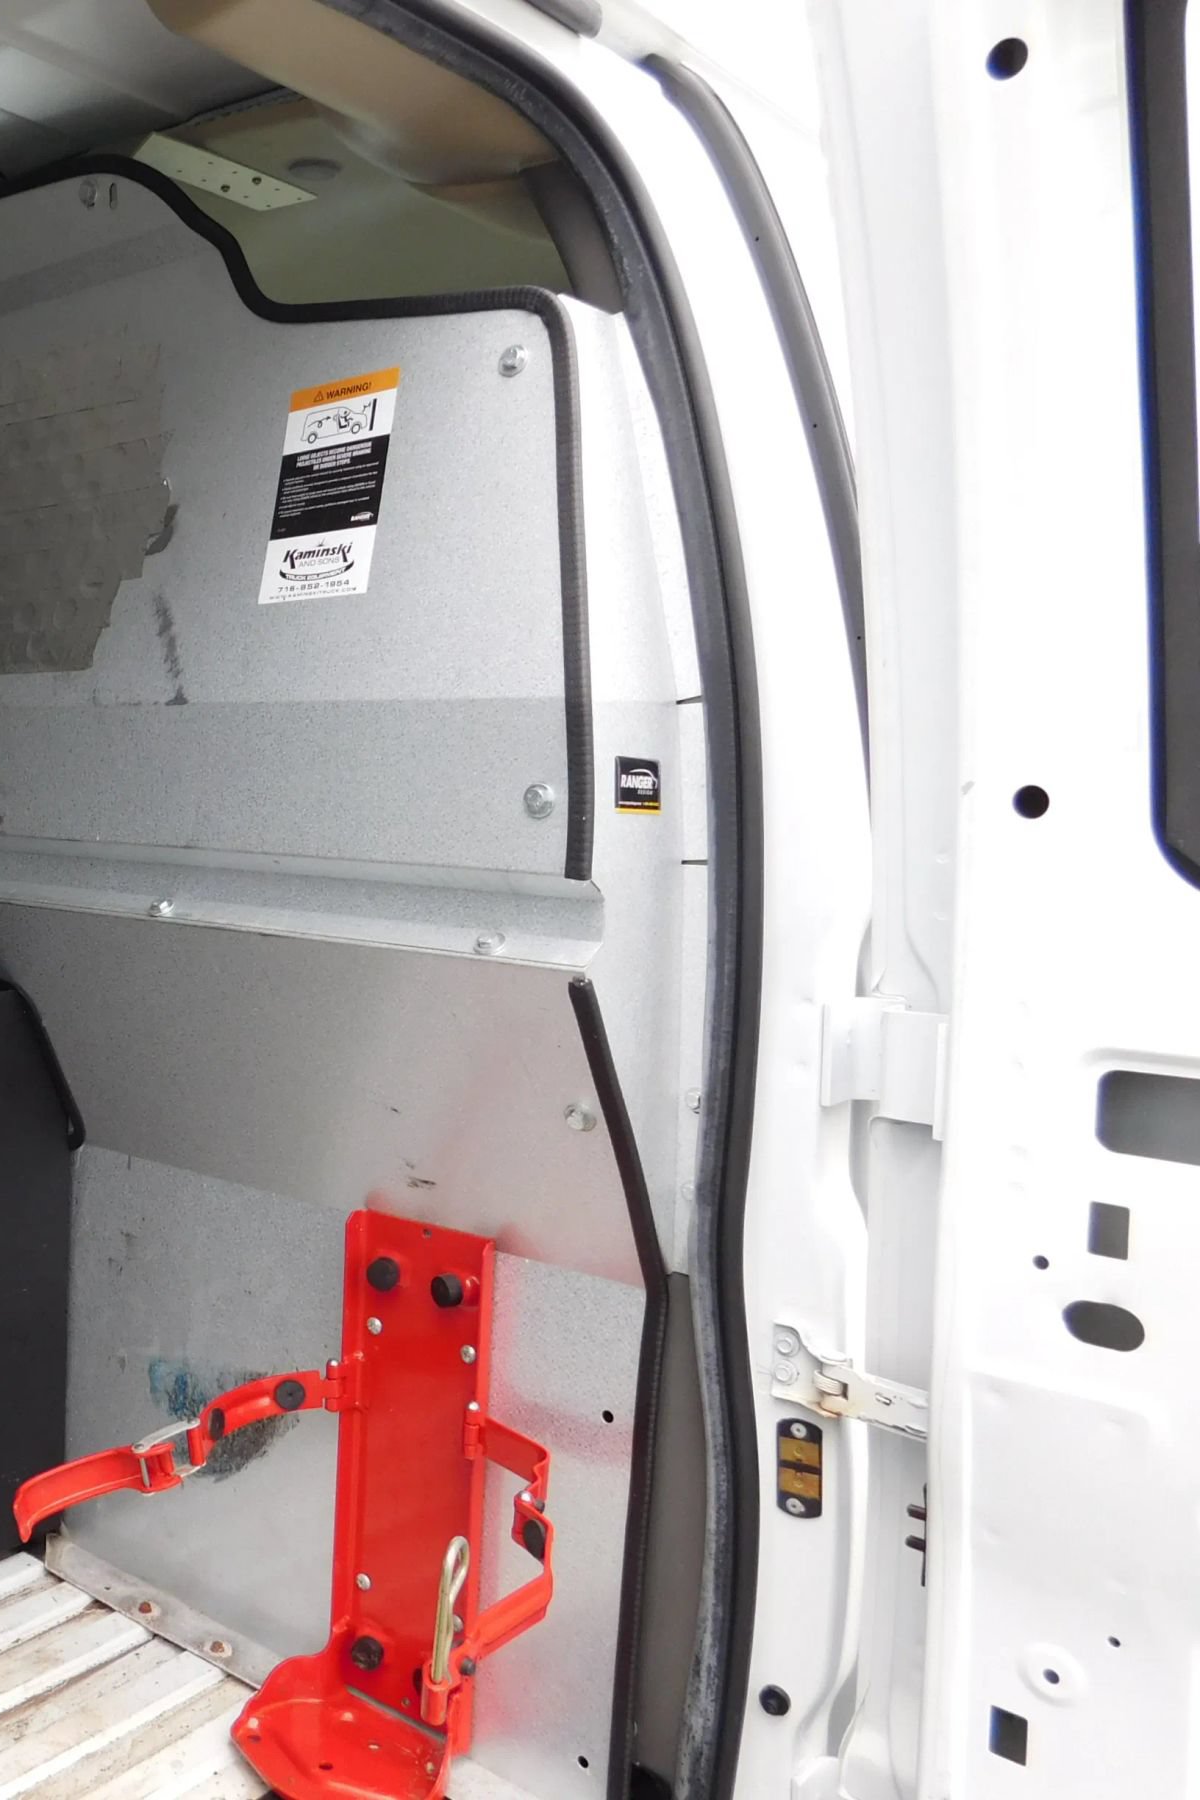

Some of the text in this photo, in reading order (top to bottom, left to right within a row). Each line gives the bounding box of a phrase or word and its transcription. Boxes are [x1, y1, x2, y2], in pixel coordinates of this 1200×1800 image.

[326, 382, 372, 400] WARNING!
[282, 541, 353, 570] Kaminski
[299, 557, 340, 568] AND SONS
[286, 573, 306, 581] TRUCK
[620, 774, 653, 789] RANGER
